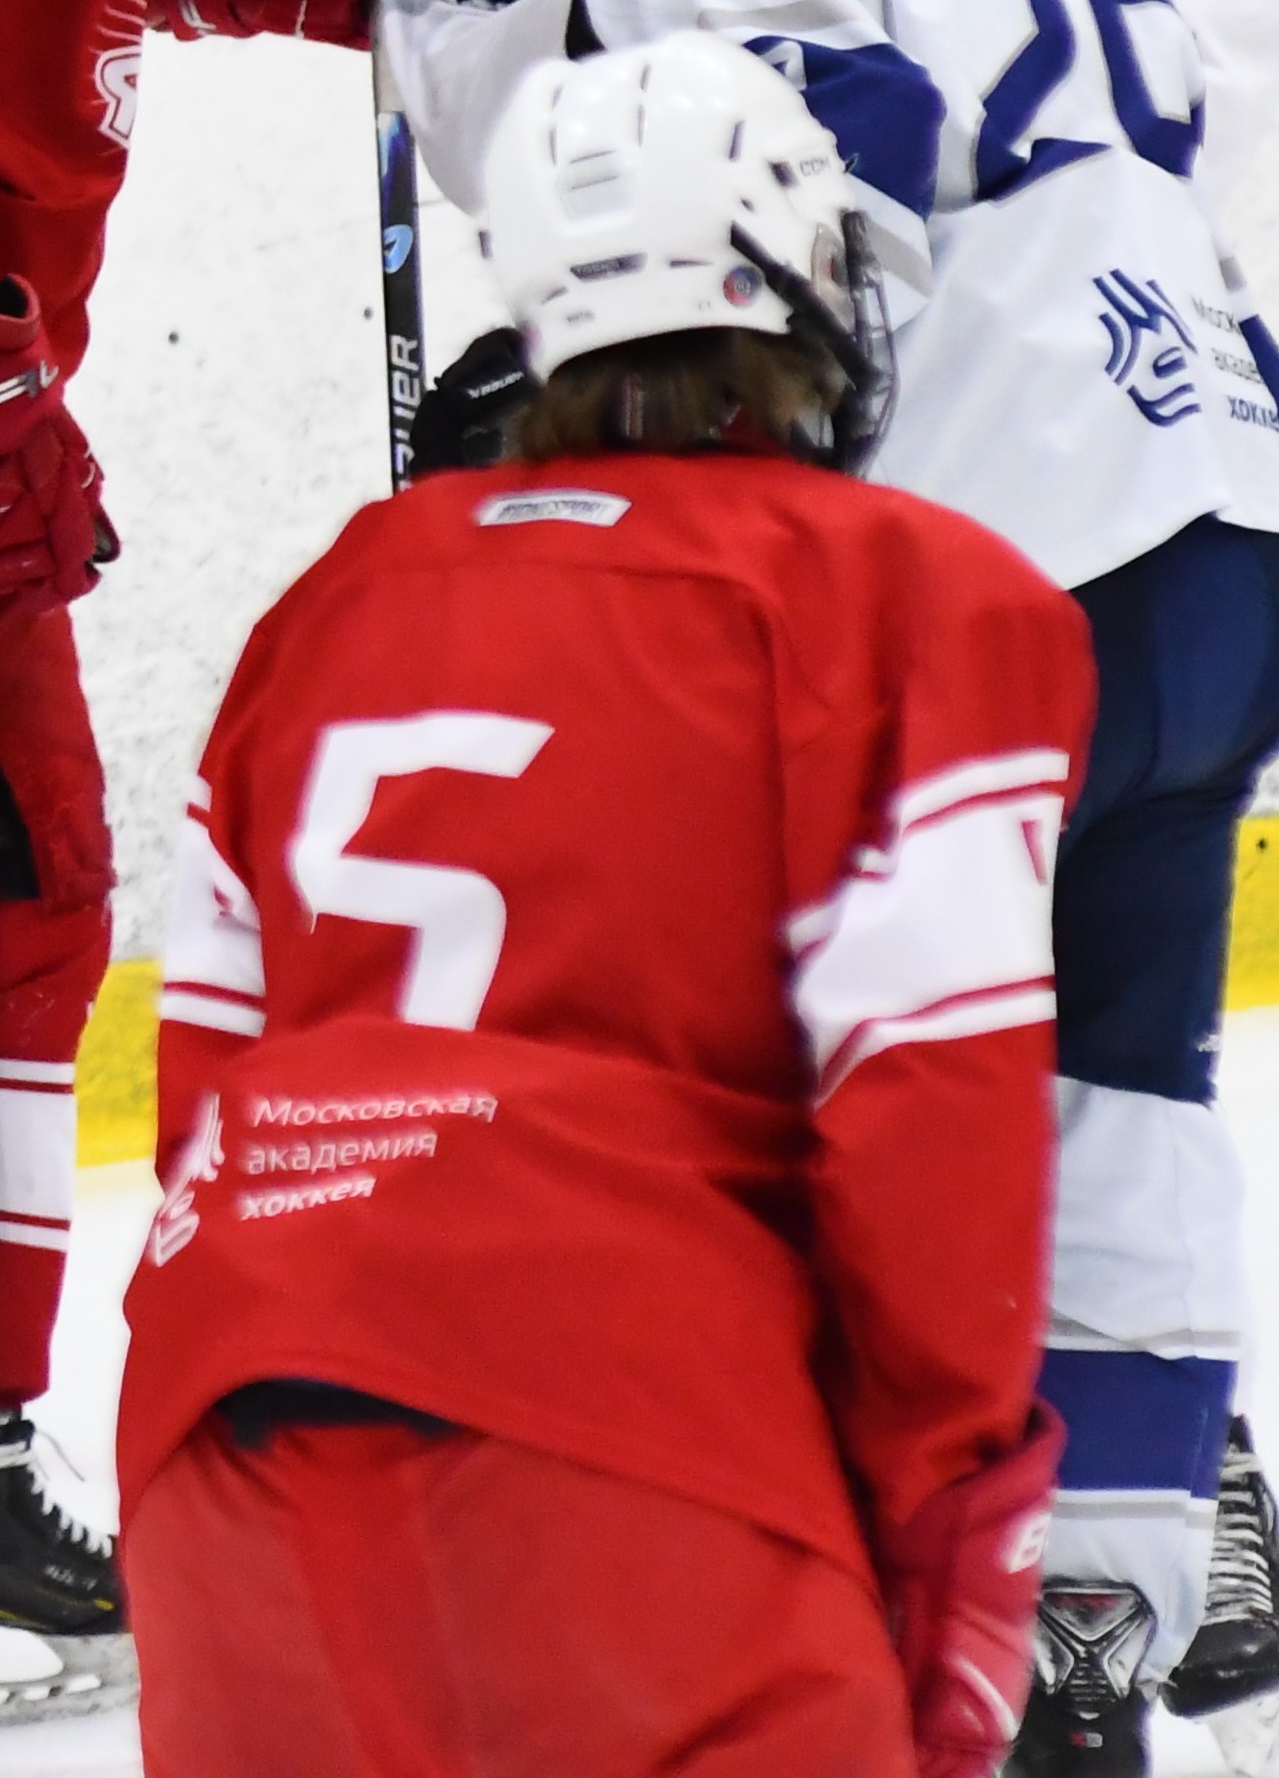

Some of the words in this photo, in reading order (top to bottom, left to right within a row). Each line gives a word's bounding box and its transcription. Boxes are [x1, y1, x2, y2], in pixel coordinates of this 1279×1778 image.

[286, 709, 555, 1032] 5
[252, 1092, 499, 1128] Московская
[246, 1130, 438, 1176] академия
[239, 1174, 378, 1222] хоккея
